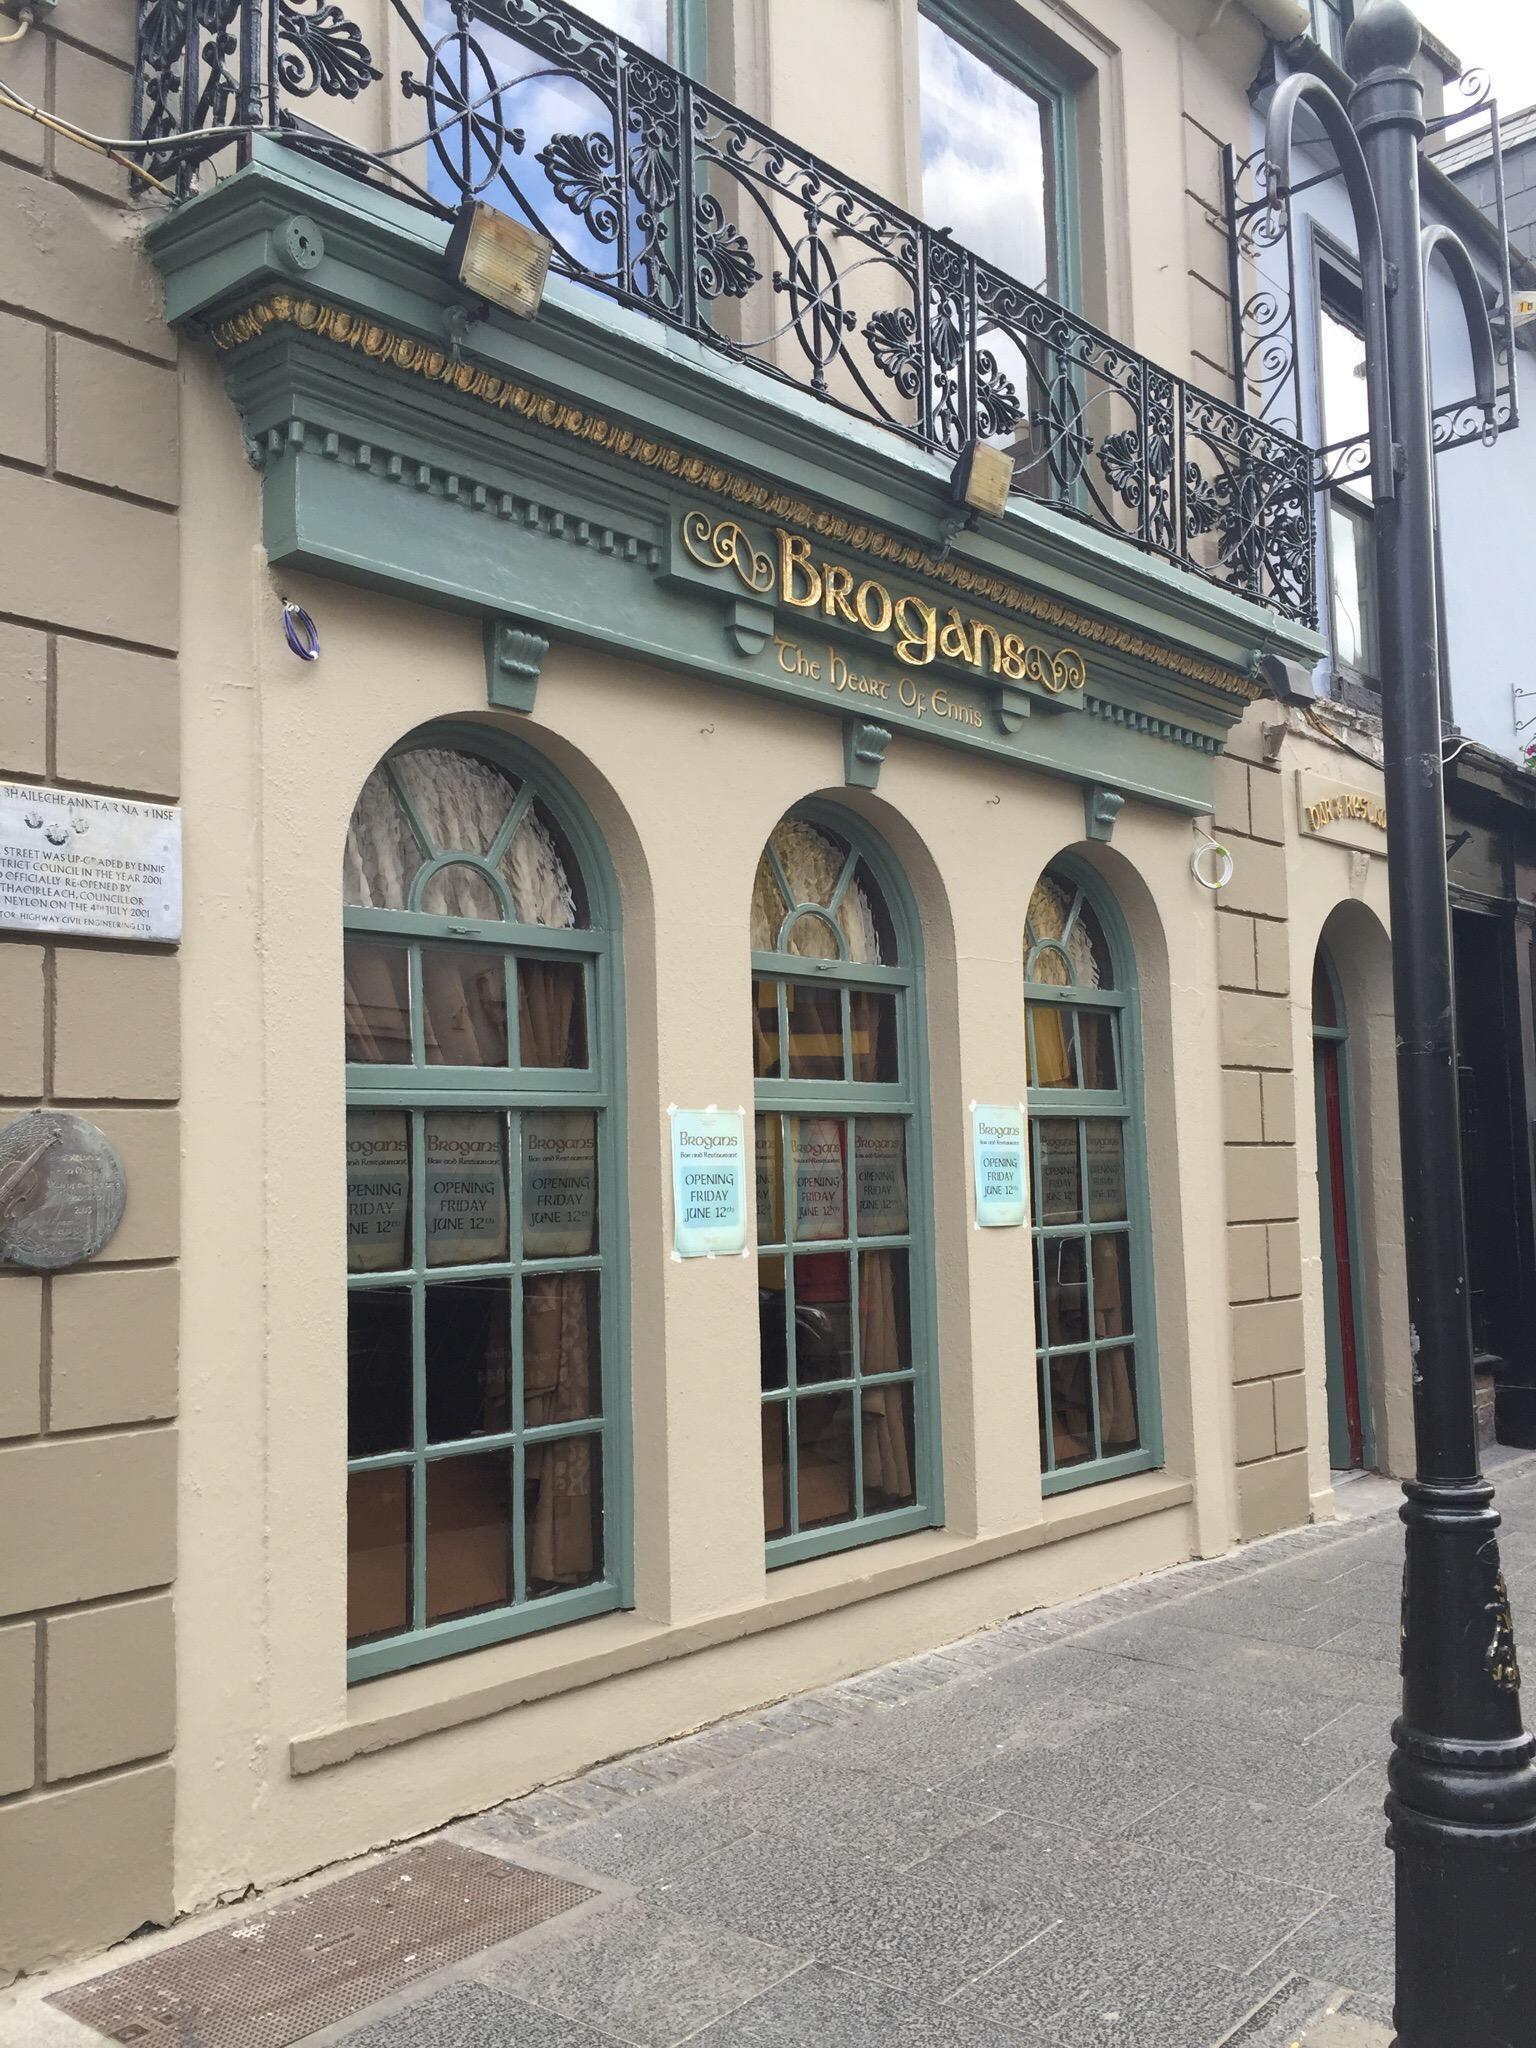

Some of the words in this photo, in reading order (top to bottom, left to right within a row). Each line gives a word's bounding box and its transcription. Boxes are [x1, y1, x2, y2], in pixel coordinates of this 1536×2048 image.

[773, 634, 822, 680] The
[827, 646, 891, 701] Heart
[898, 677, 927, 719] Of
[931, 688, 983, 728] Ennis
[122, 804, 139, 817] NA
[3, 846, 40, 860] STREET
[42, 851, 66, 862] WAS
[125, 861, 137, 870] BY
[137, 862, 166, 874] ENNIS
[32, 863, 80, 876] COUNCIL
[81, 868, 93, 877] IN
[95, 869, 114, 880] THE
[115, 871, 141, 883] YEAR
[142, 875, 162, 886] 2001
[5, 871, 62, 886] OFFICIALLY
[64, 877, 119, 892] RE-OPENED
[120, 883, 132, 893] BY
[79, 891, 144, 906] COUNCILLOR
[4, 896, 49, 908] NEYLON
[49, 900, 68, 910] ON
[69, 901, 89, 912] THE
[105, 905, 128, 916] JULY
[20, 912, 60, 923] HIGHWAY
[61, 916, 82, 925] CIVIL
[979, 1122, 1020, 1138] Brogans
[427, 1135, 500, 1156] Brogans
[528, 1134, 594, 1153] Brogans
[680, 1131, 738, 1149] Brogans
[983, 1157, 1018, 1168] OPENING
[532, 1176, 590, 1190] OPENING
[685, 1173, 734, 1186] OPENING
[797, 1176, 840, 1188] OPENING
[987, 1171, 1014, 1181] FRIDAY
[433, 1181, 495, 1195] OPENING
[984, 1185, 1003, 1197] JUNE
[537, 1194, 583, 1206] FRIDAY
[690, 1190, 729, 1202] FRIDAY
[801, 1191, 836, 1202] FRIDAY
[440, 1200, 487, 1212] FRIDAY
[529, 1211, 561, 1227] JUNE
[684, 1207, 711, 1222] JUNE
[432, 1217, 464, 1233] JUNE
